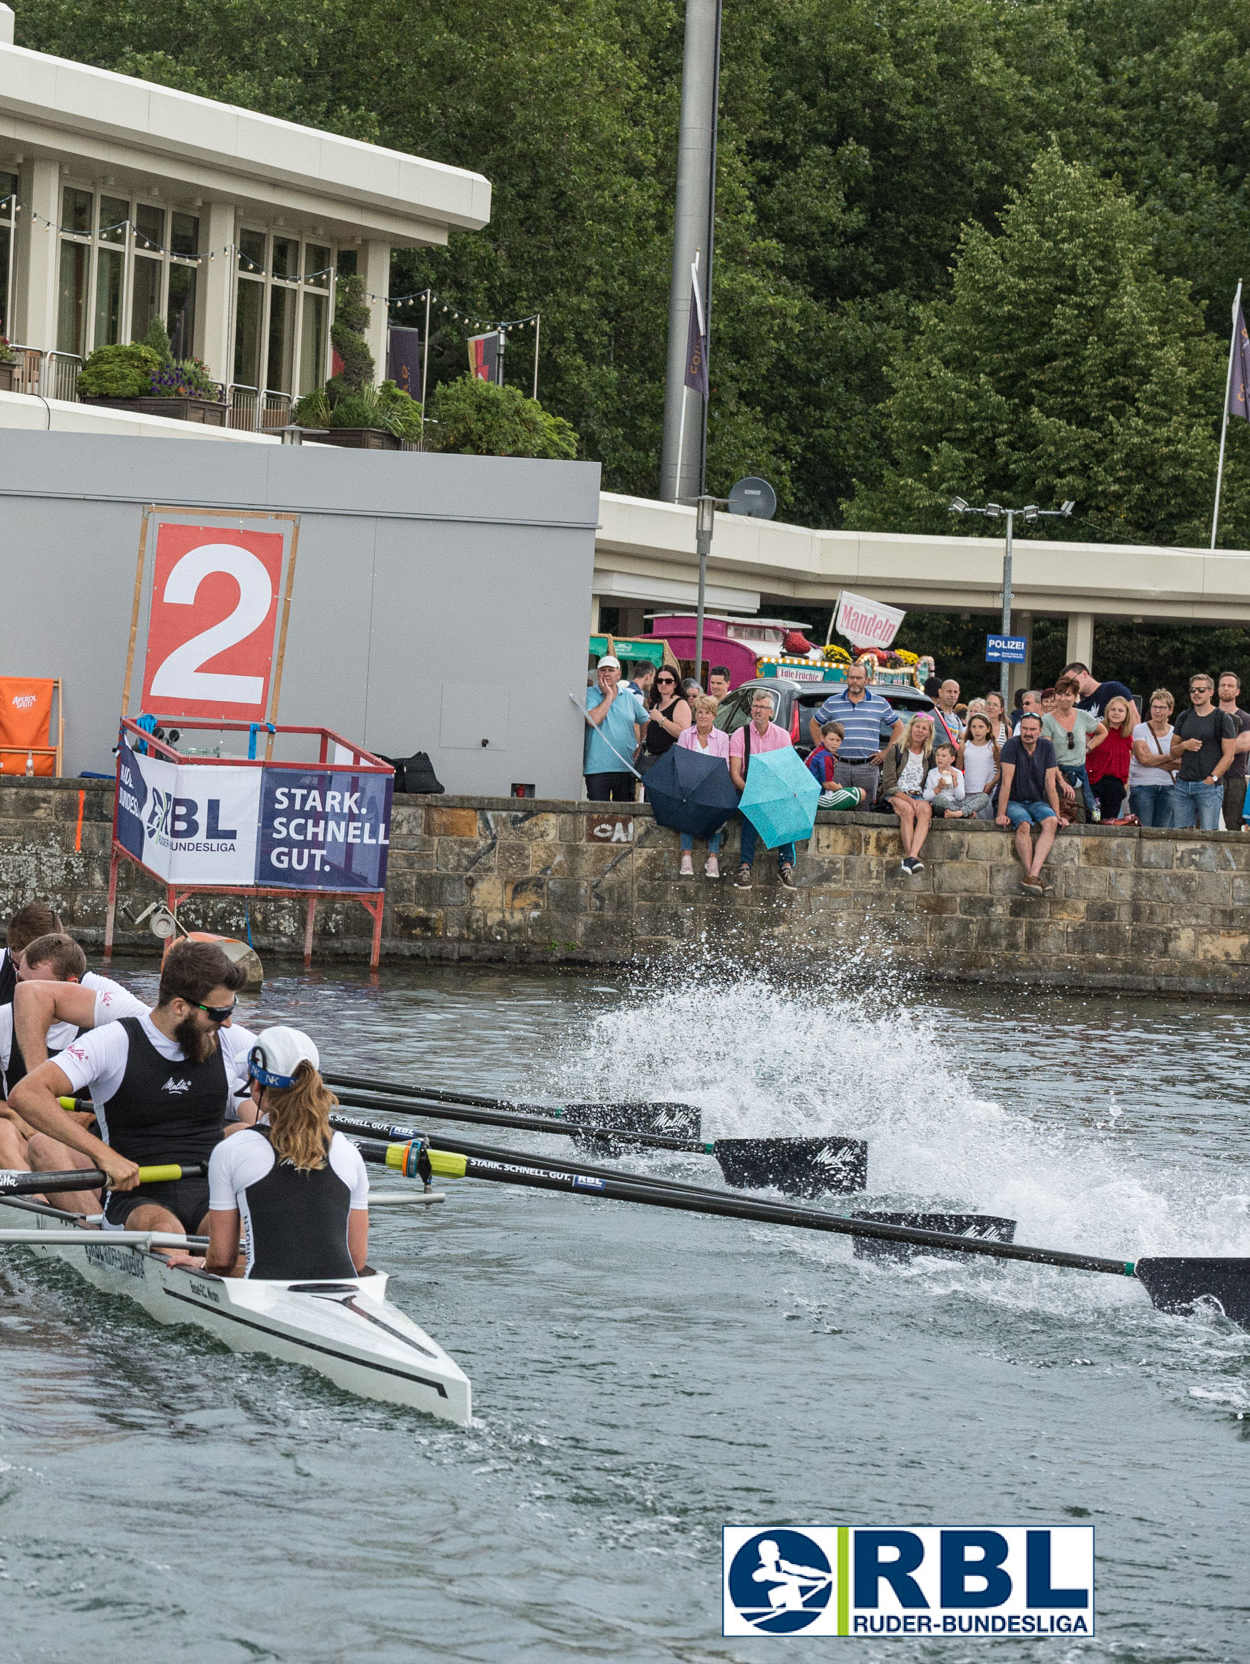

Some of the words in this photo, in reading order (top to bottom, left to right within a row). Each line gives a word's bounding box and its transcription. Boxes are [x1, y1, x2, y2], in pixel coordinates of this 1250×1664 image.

[150, 543, 272, 705] 2
[840, 604, 896, 643] Mandeln
[988, 639, 1025, 650] POLIZEI
[274, 787, 367, 815] STARK.
[270, 846, 330, 872] GUT.
[335, 1115, 370, 1128] SCHNELL.
[371, 1122, 389, 1132] GUT.
[469, 1158, 503, 1170] STARK.
[504, 1163, 548, 1178] SCHNELL.
[549, 1172, 571, 1181] GUT.
[577, 1175, 603, 1185] RBL
